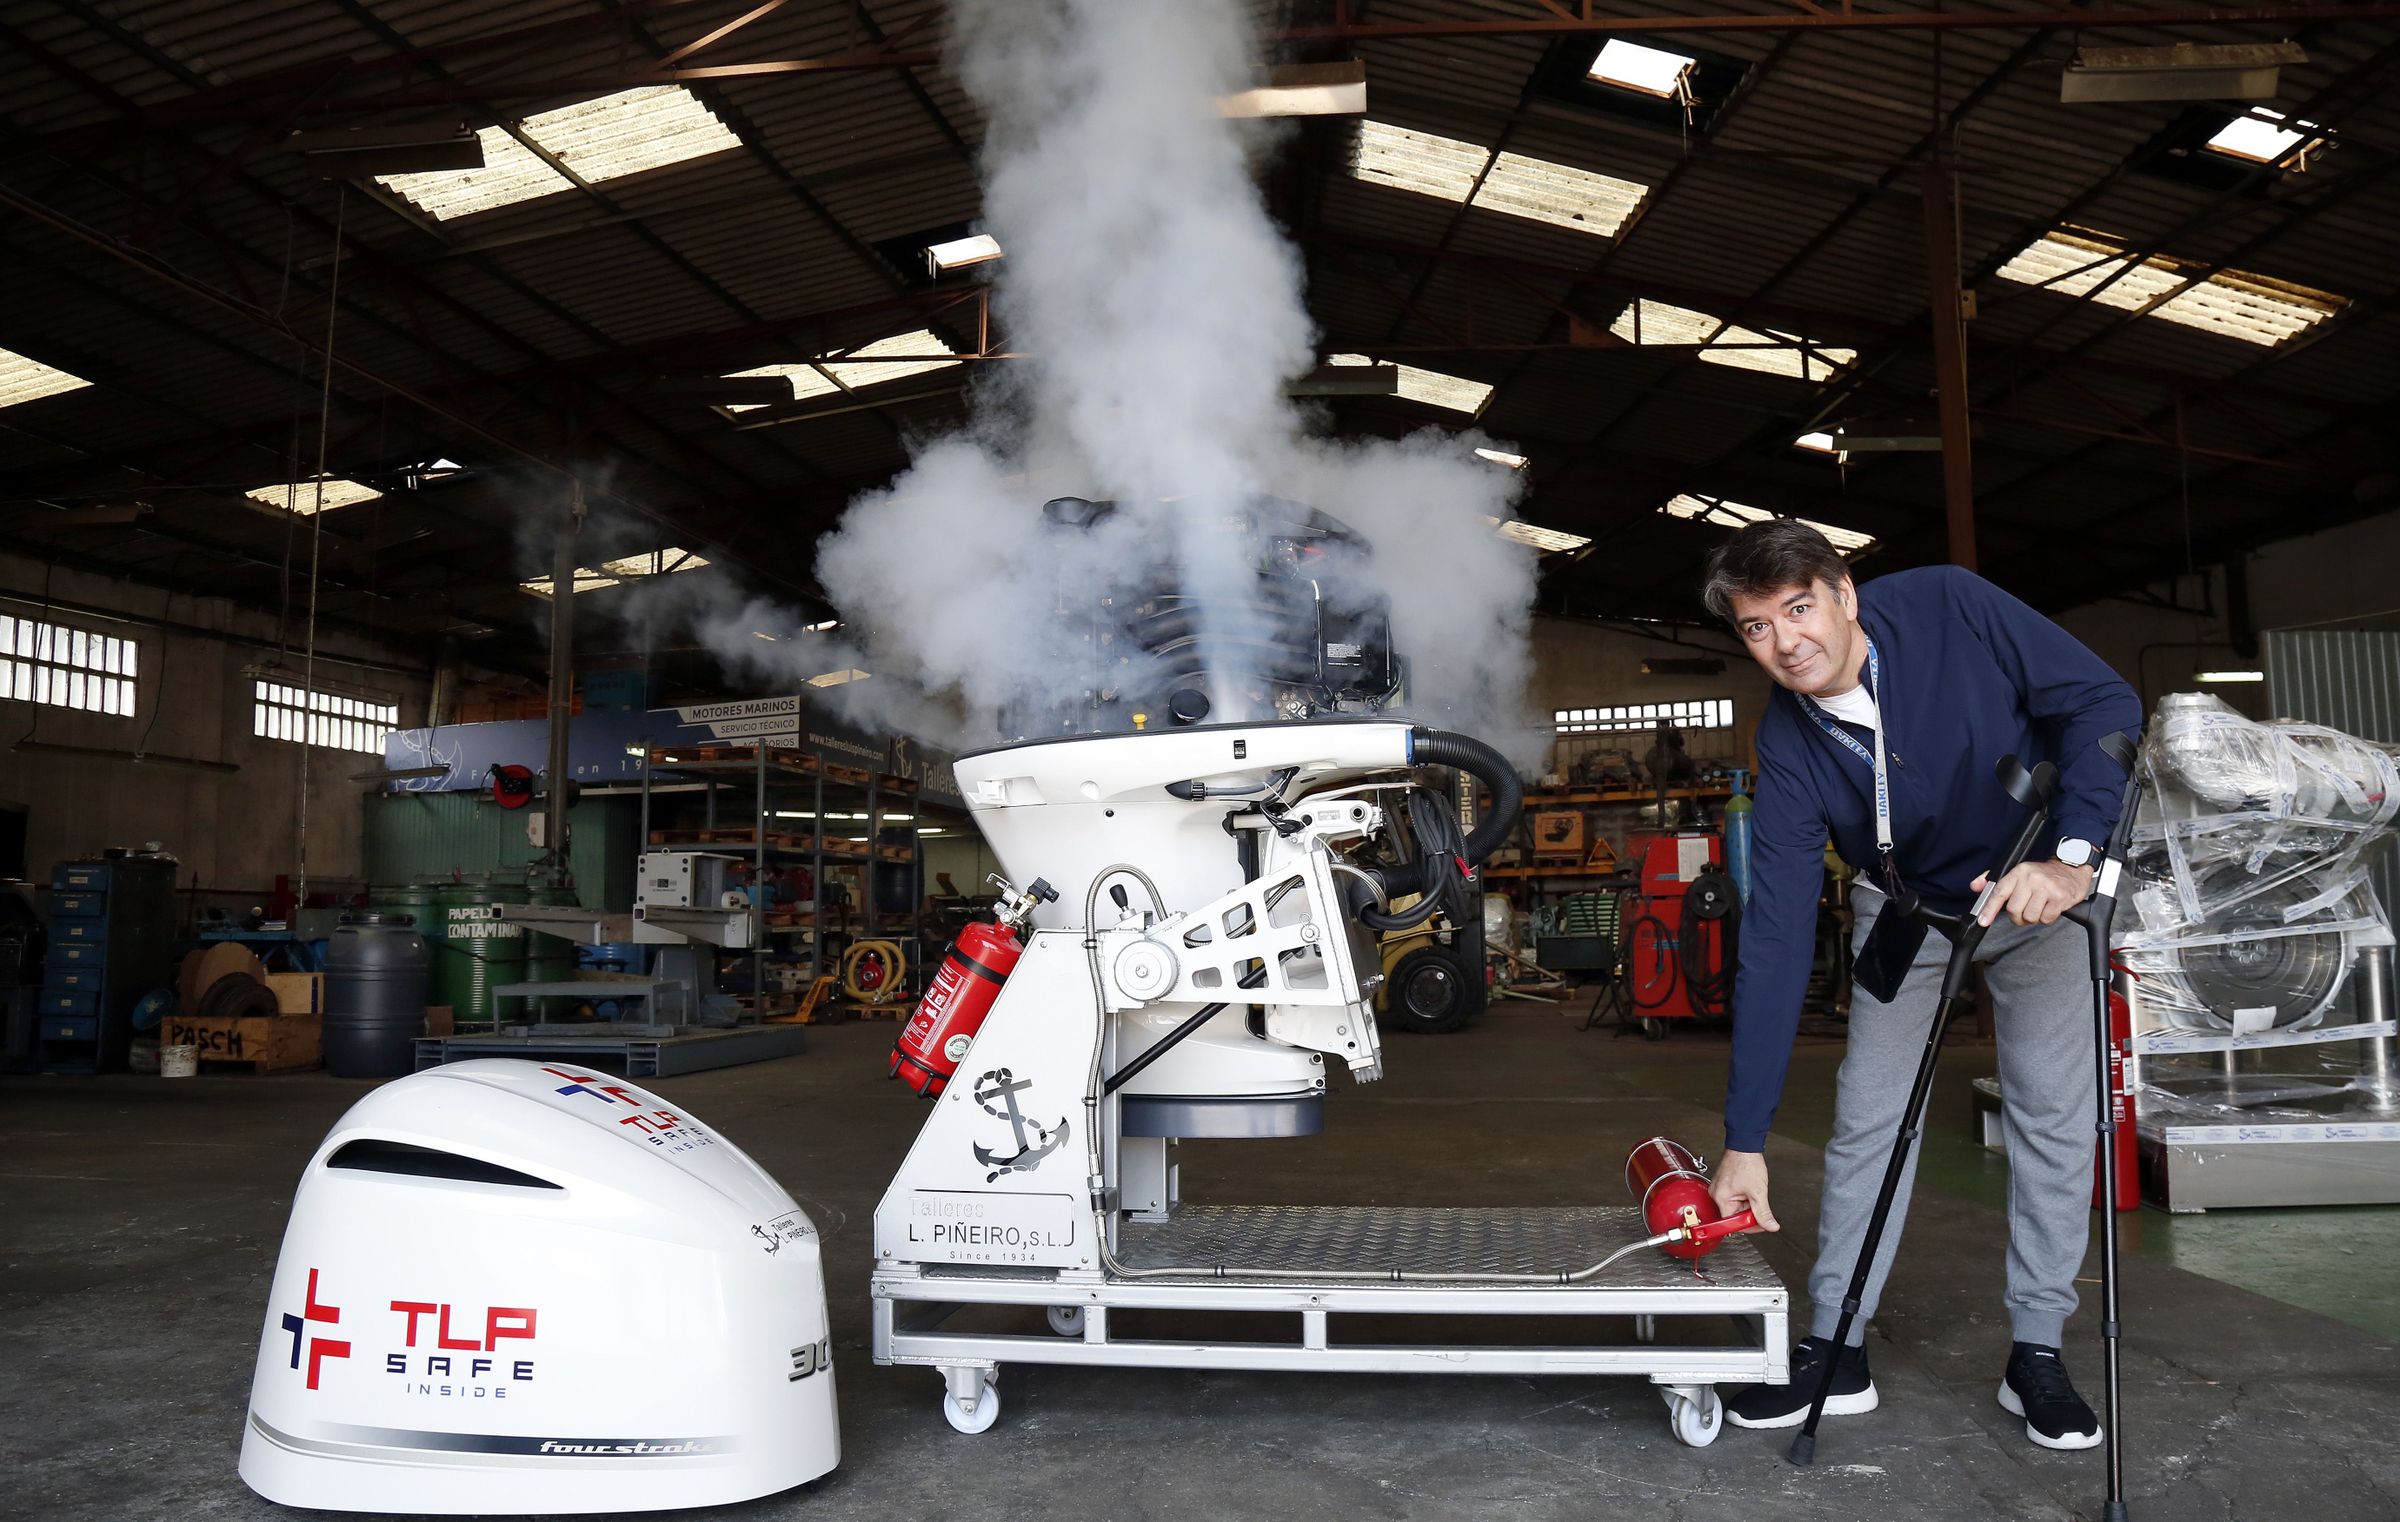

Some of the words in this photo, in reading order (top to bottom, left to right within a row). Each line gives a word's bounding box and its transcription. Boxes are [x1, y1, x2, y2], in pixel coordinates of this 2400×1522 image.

[692, 705, 742, 719] MOTORES
[745, 700, 795, 714] MARINOS
[721, 723, 757, 734] SERVICIO
[621, 759, 642, 772] 19
[1877, 773, 1888, 817] OAKLEY
[171, 1024, 243, 1057] PASCH
[619, 1111, 682, 1134] TLP
[648, 1127, 703, 1146] SAFE
[909, 1197, 984, 1217] Talleres
[950, 1251, 990, 1261] Since
[1002, 1253, 1036, 1262] 1934
[390, 1300, 537, 1352] TLP
[386, 1353, 534, 1381] SAFE
[407, 1383, 507, 1399] INSIDE
